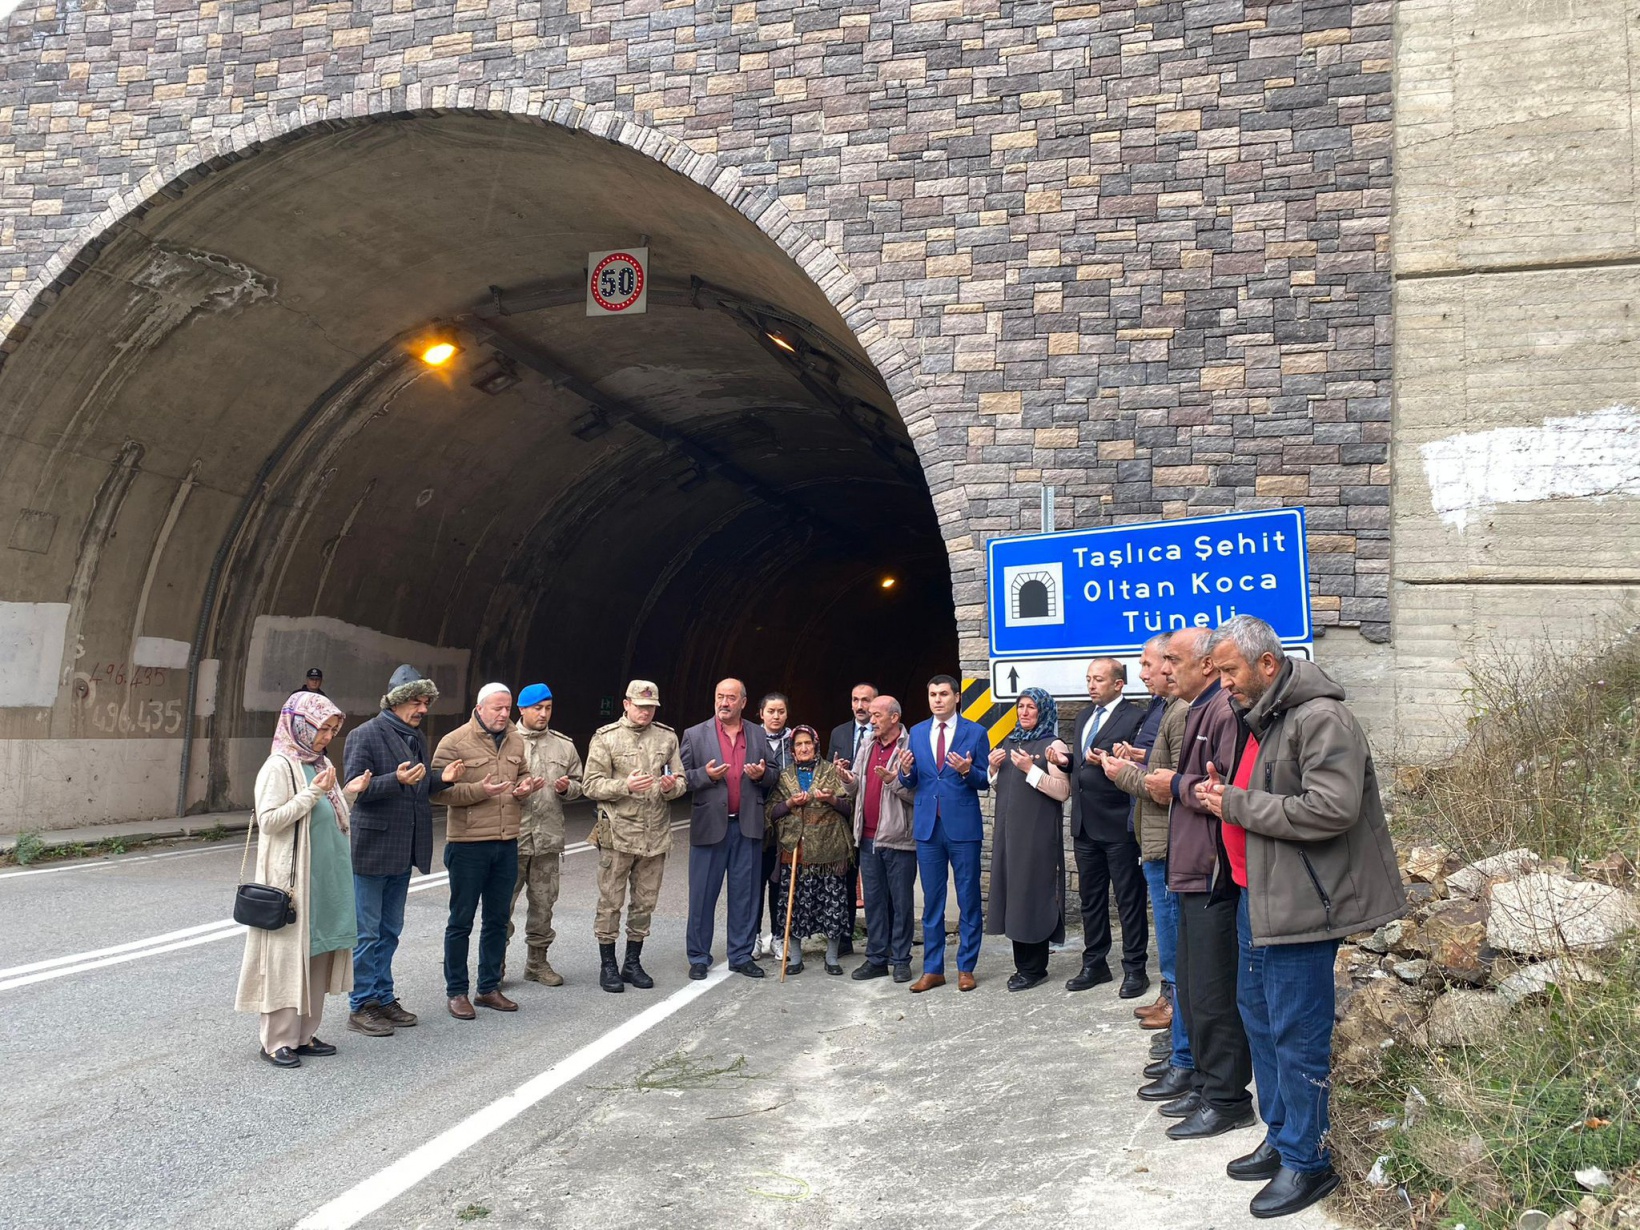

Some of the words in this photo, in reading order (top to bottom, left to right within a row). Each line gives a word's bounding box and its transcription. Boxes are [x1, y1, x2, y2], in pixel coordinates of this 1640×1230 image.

[601, 267, 634, 298] 50
[1072, 542, 1182, 569] Taşlıca
[1194, 531, 1286, 562] Şehit
[1083, 579, 1175, 602] Oltan
[1191, 571, 1277, 595] Koca
